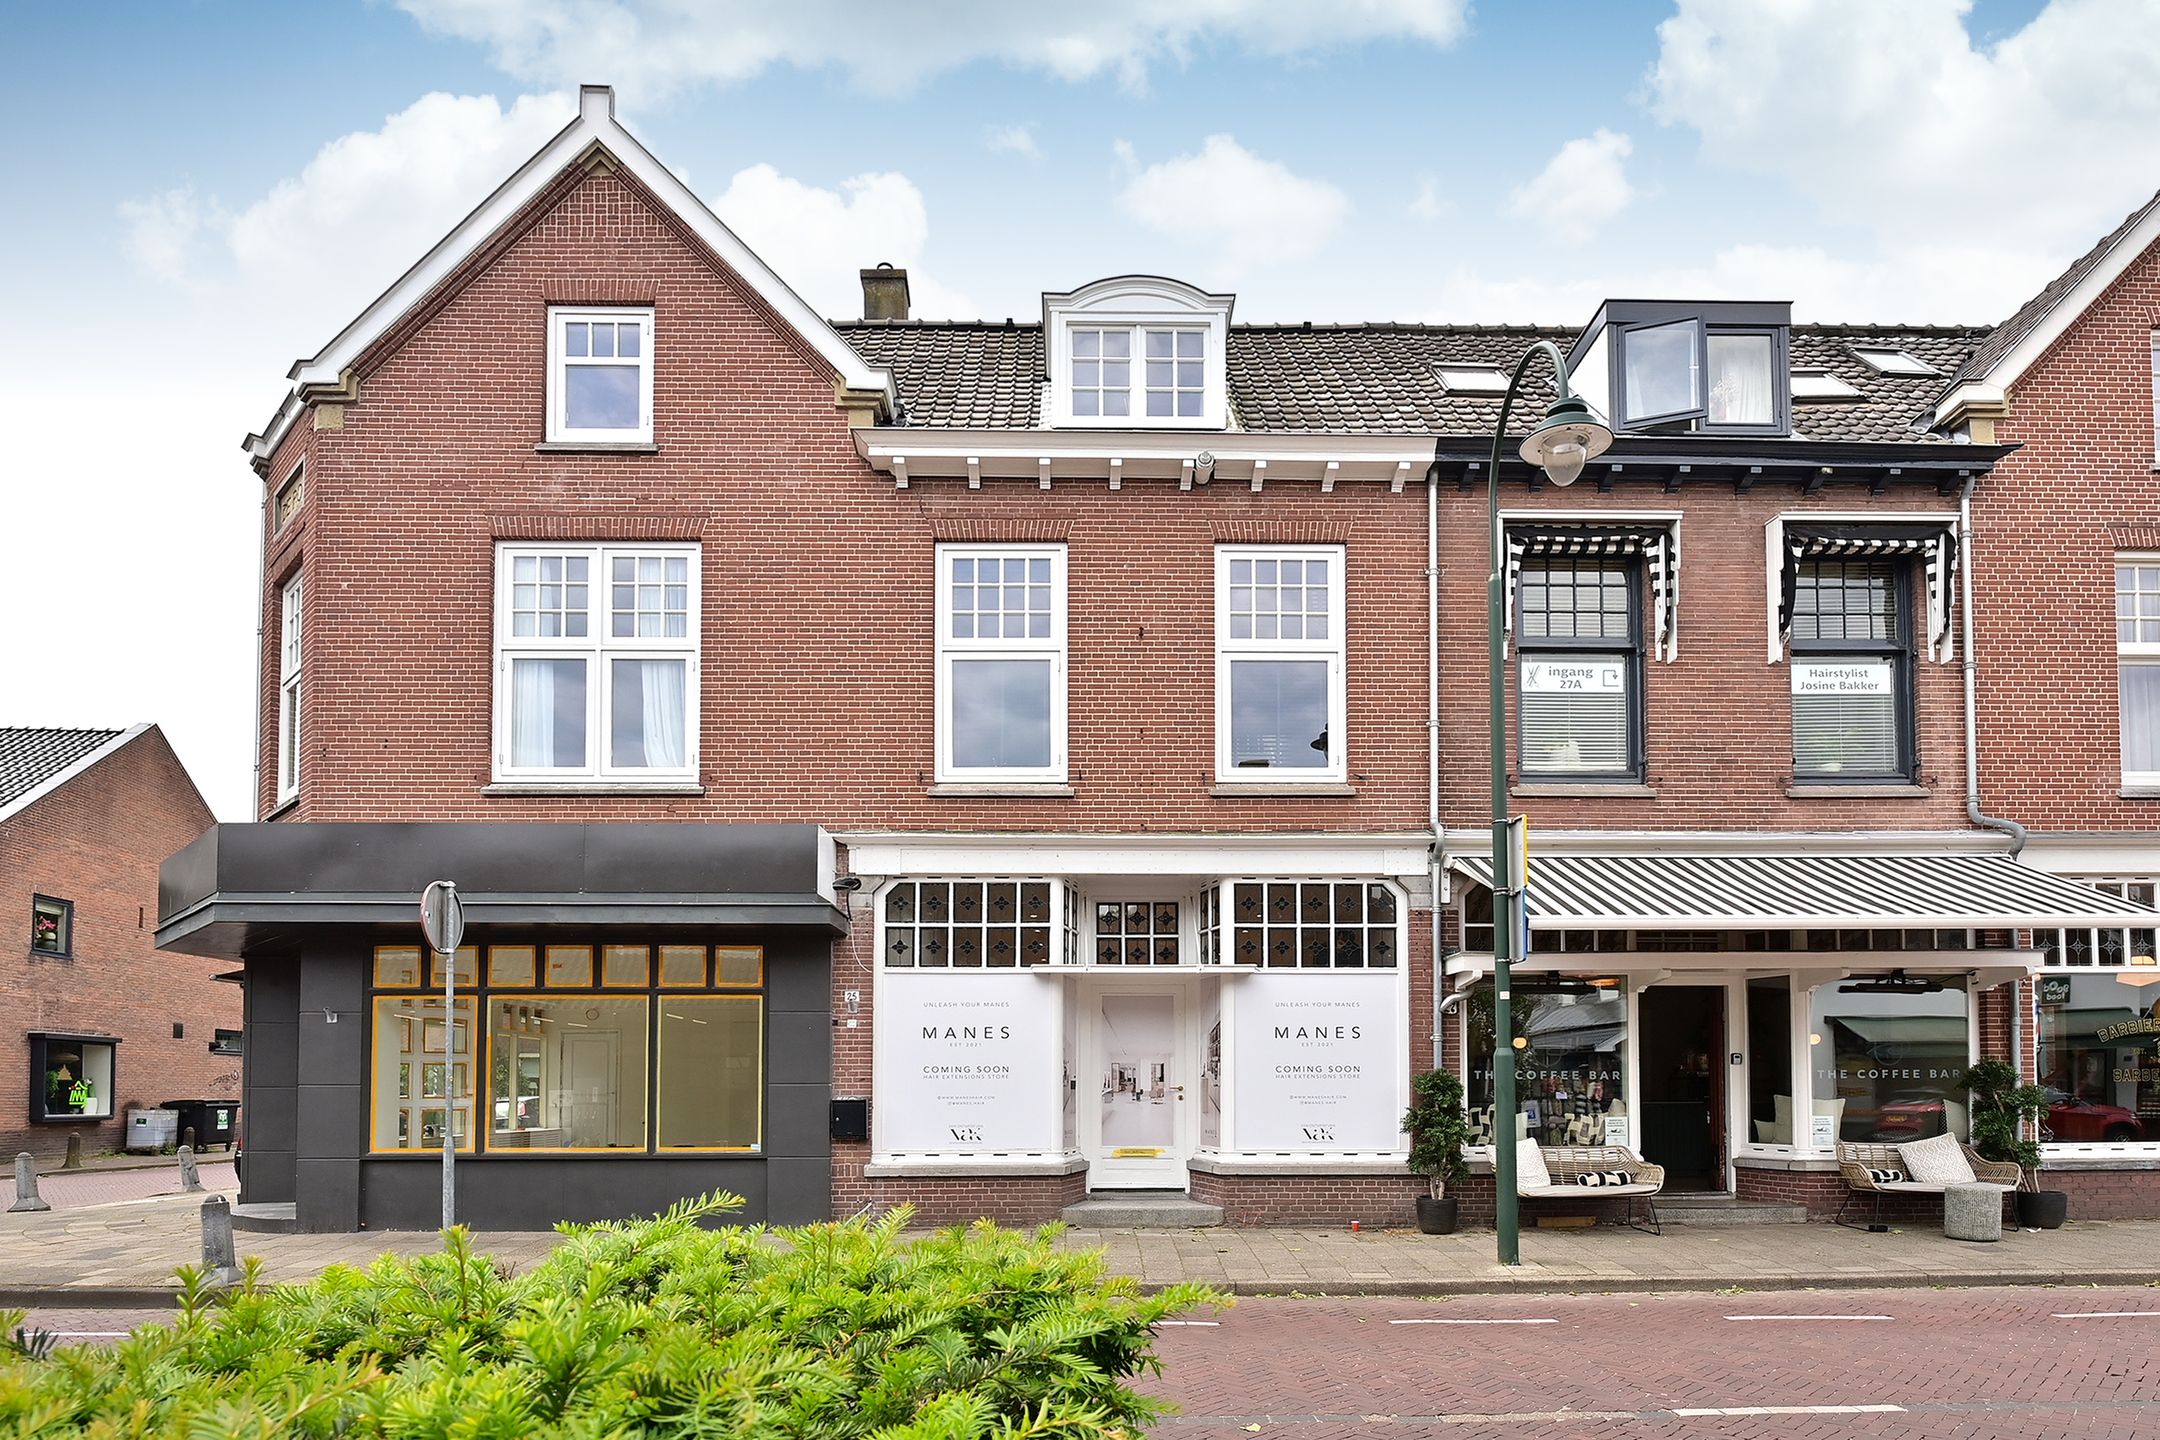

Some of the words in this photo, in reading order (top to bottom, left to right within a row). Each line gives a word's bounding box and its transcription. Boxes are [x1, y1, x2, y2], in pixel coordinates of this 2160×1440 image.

[1548, 666, 1593, 678] ingang
[1809, 668, 1869, 679] Hairstylist
[1560, 680, 1582, 689] 27A
[1800, 681, 1836, 690] Josine
[1839, 681, 1880, 690] Bakker
[846, 992, 858, 1001] 25
[922, 1026, 1010, 1039] MANES
[1274, 1026, 1361, 1039] MANES
[923, 1065, 971, 1074] COMING
[976, 1065, 1010, 1074] SOON
[1275, 1065, 1323, 1074] COMING
[1328, 1065, 1361, 1074] SOON
[1817, 1069, 1848, 1079] THE
[1857, 1069, 1921, 1079] COFFEE
[1929, 1069, 1961, 1079] BAR
[1474, 1070, 1494, 1080] TH
[1515, 1070, 1580, 1080] COFFEE
[1589, 1070, 1621, 1080] BAR
